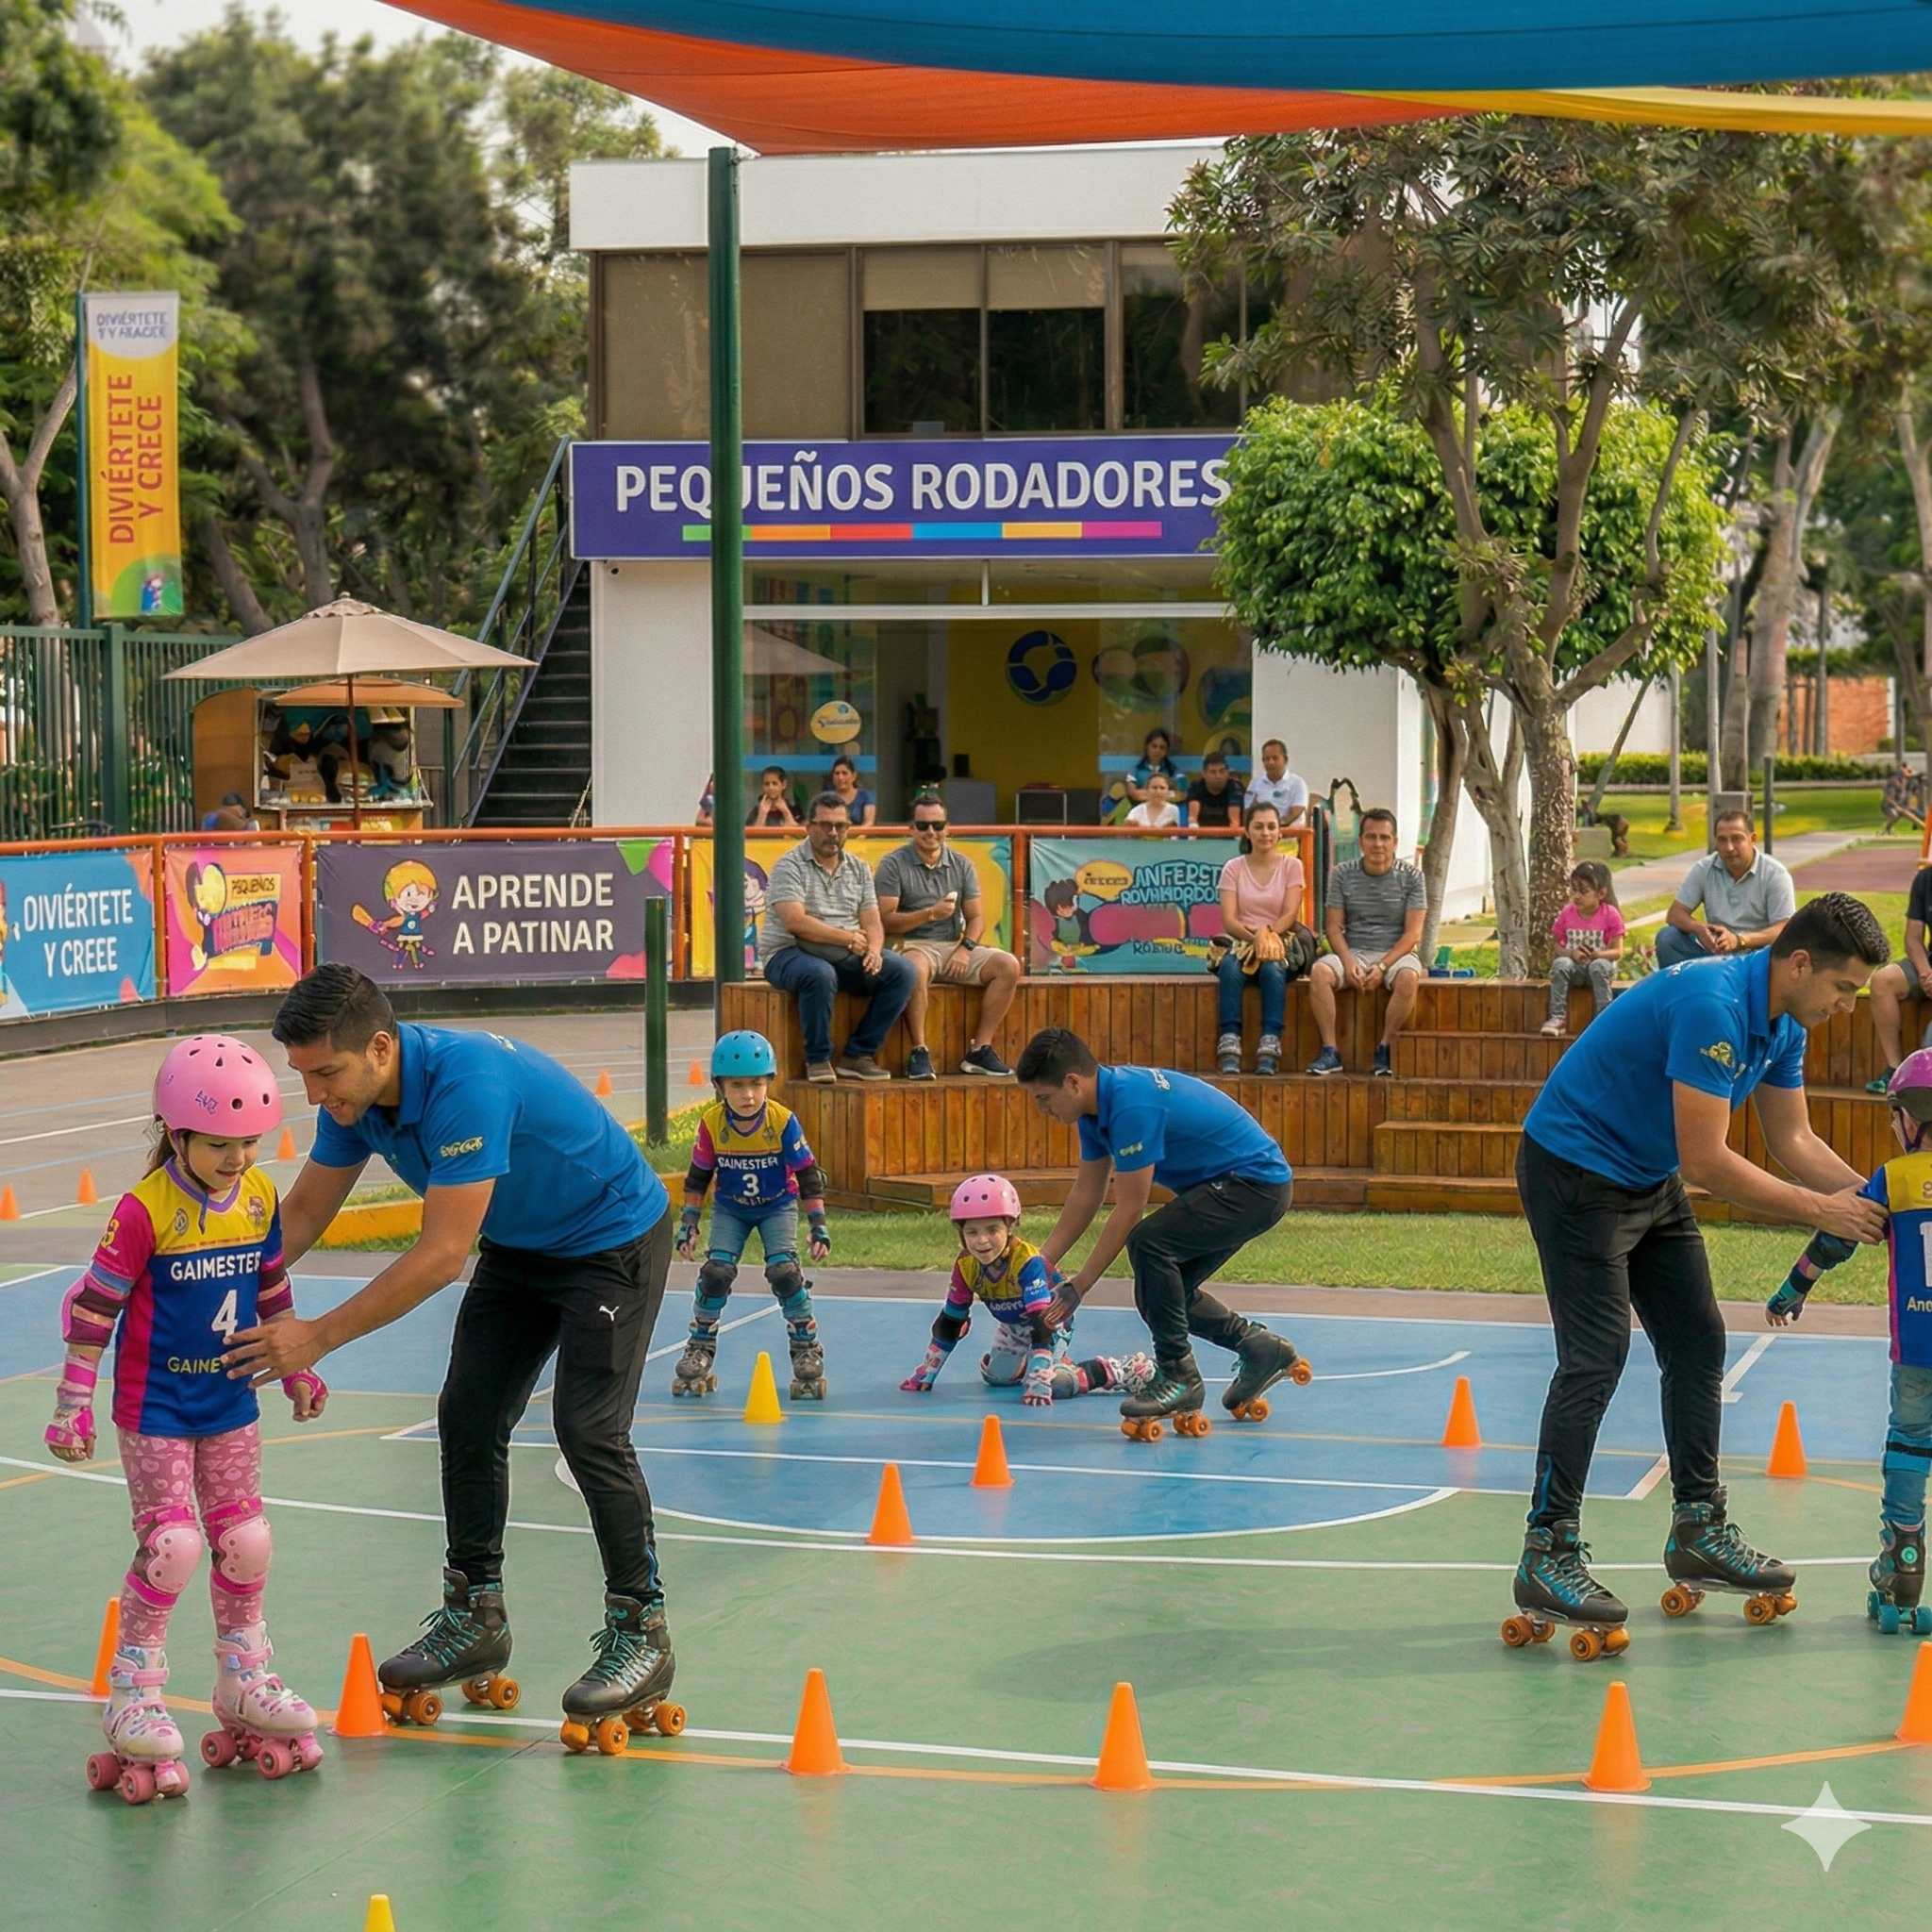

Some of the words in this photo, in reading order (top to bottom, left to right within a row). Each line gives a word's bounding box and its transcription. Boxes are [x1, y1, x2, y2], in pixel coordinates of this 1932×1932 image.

[100, 375, 134, 543] DIVIÉRTETE
[137, 395, 162, 490] CRECE
[616, 450, 894, 519] PEQEÑOS
[912, 458, 1232, 510] RODADORES
[138, 501, 163, 519] Y
[451, 873, 614, 910] APRENDE
[452, 922, 475, 955] A
[483, 919, 614, 955] PATINAR
[43, 941, 57, 978] Y
[60, 936, 118, 976] CREEE
[741, 1173, 760, 1197] 3
[210, 1289, 238, 1339] 4
[167, 1356, 225, 1374] GAINE
